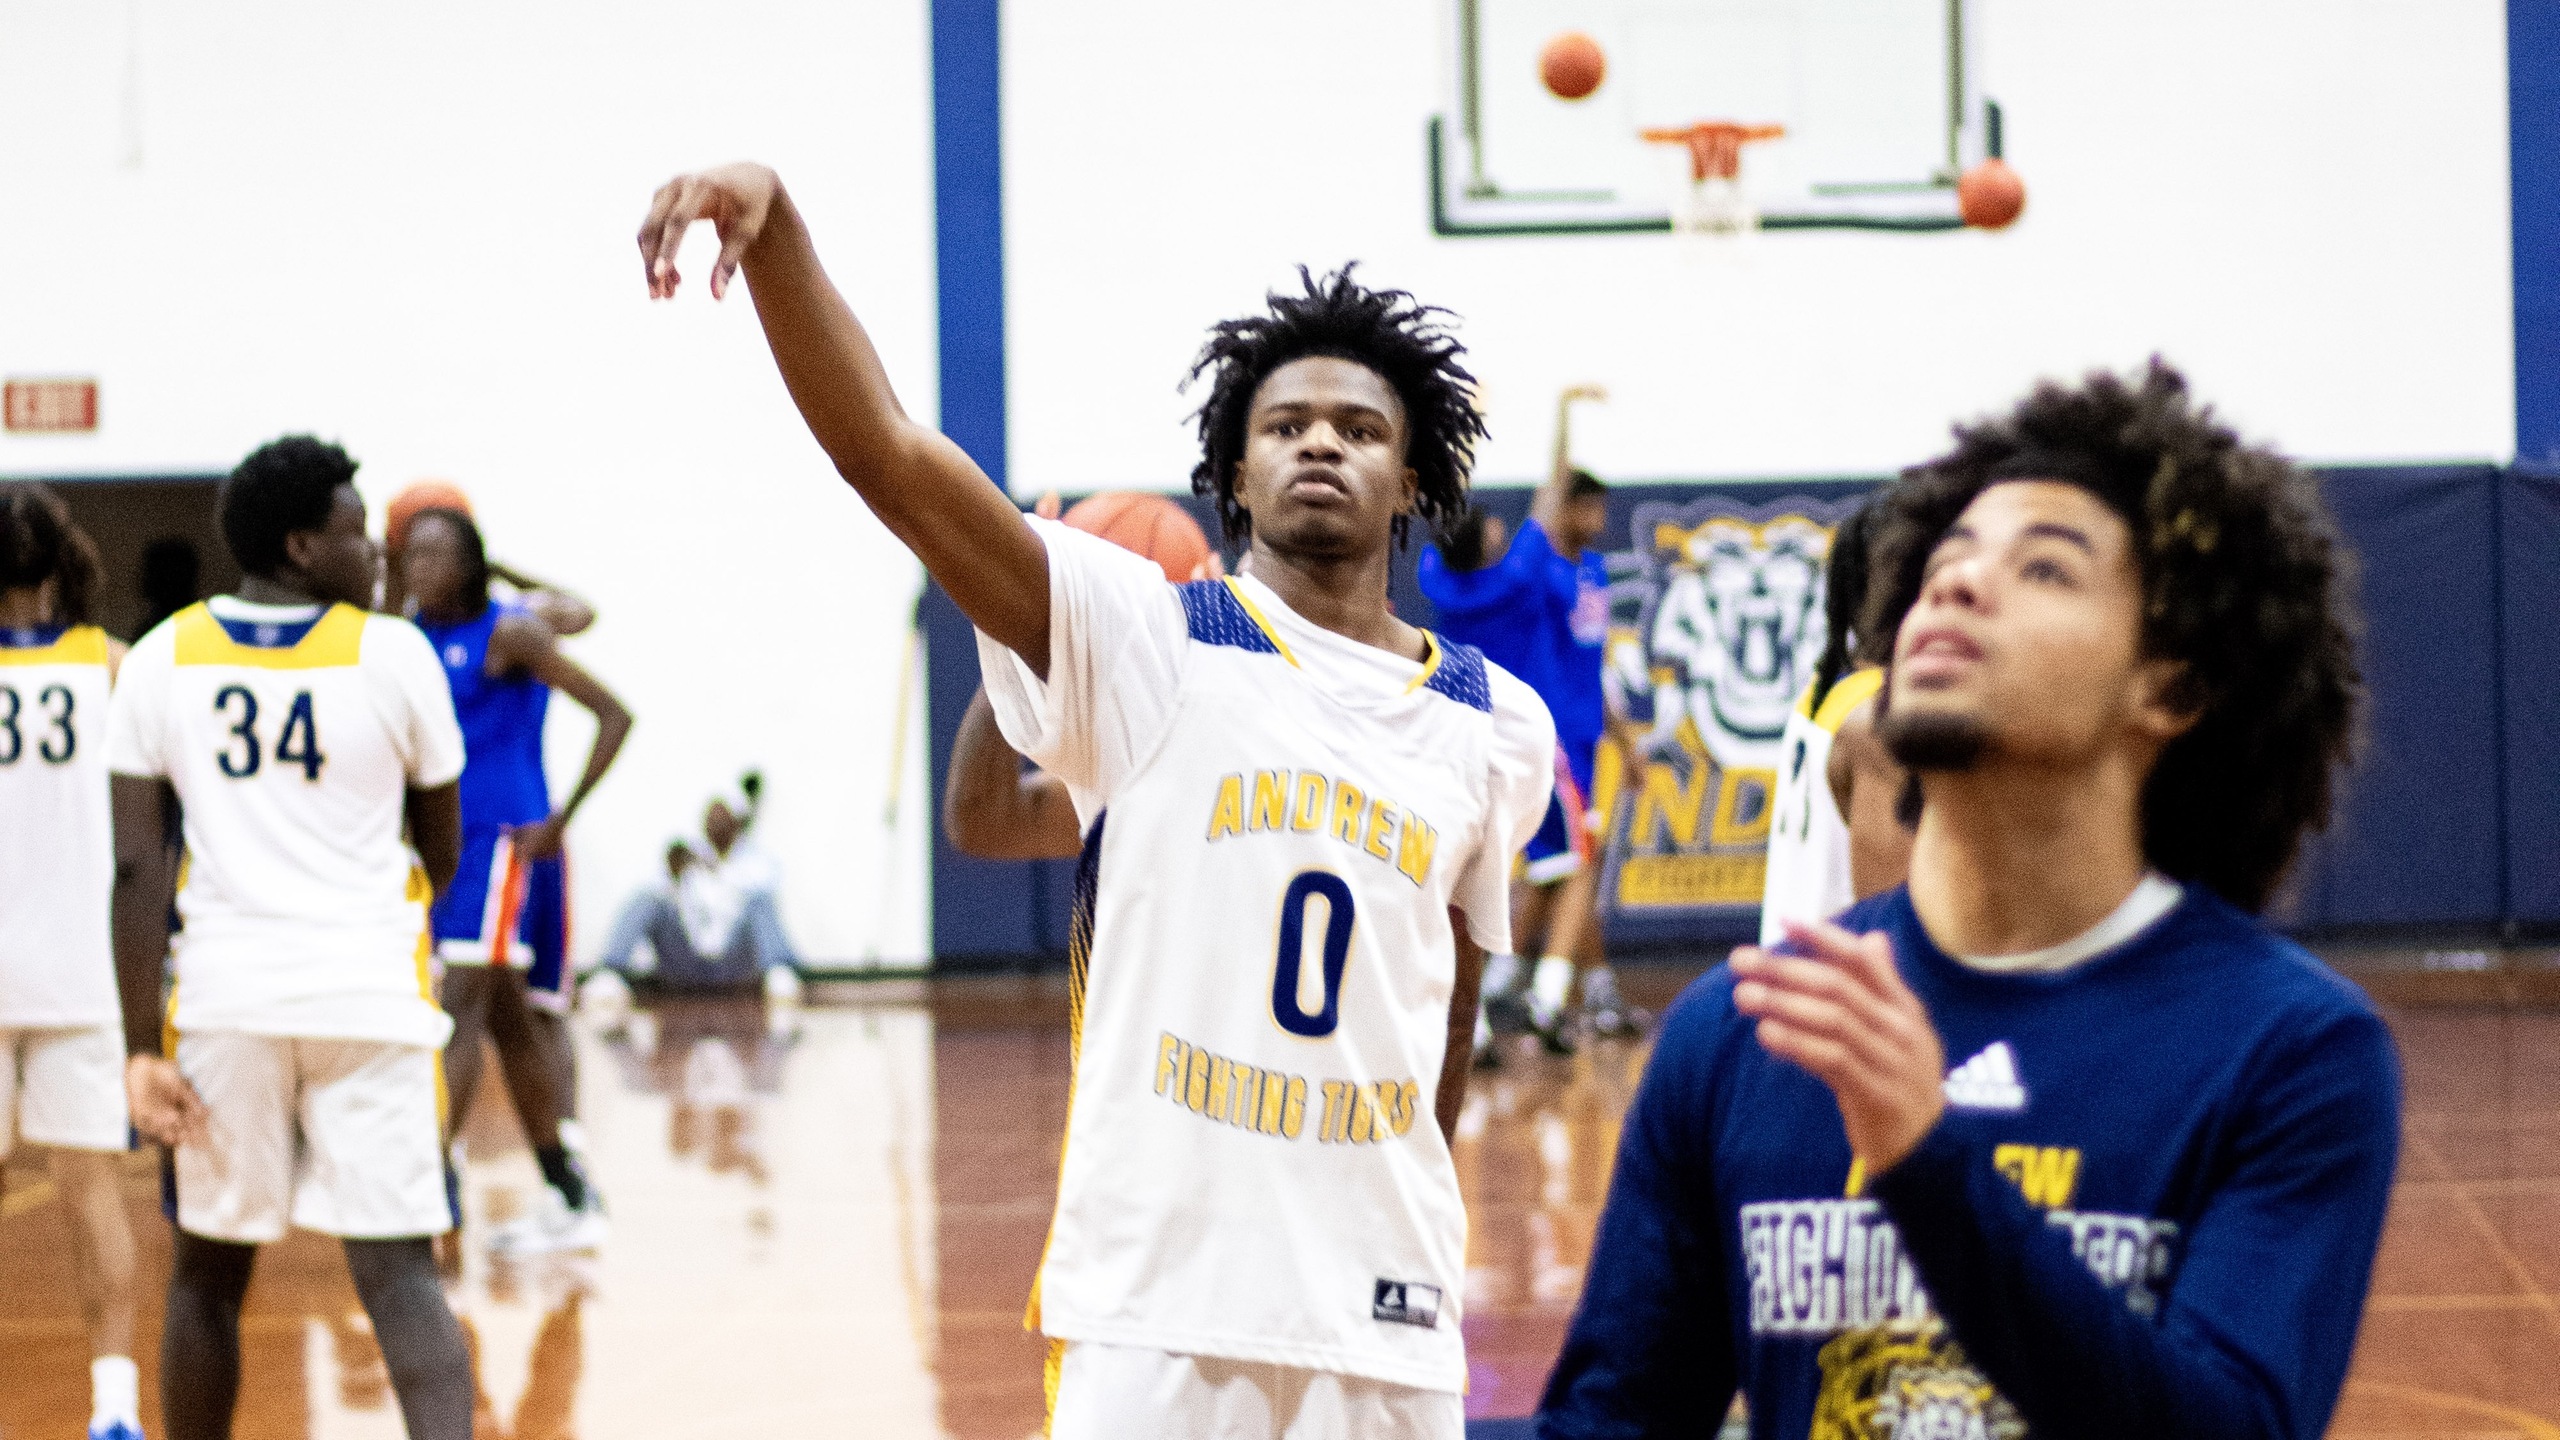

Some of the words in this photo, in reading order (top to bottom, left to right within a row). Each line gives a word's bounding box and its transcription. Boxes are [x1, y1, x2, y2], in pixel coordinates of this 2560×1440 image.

[214, 683, 327, 782] 34
[1206, 768, 1438, 888] ANDREW
[1268, 866, 1357, 1042] 0
[1153, 1030, 1307, 1142] FIGHTING
